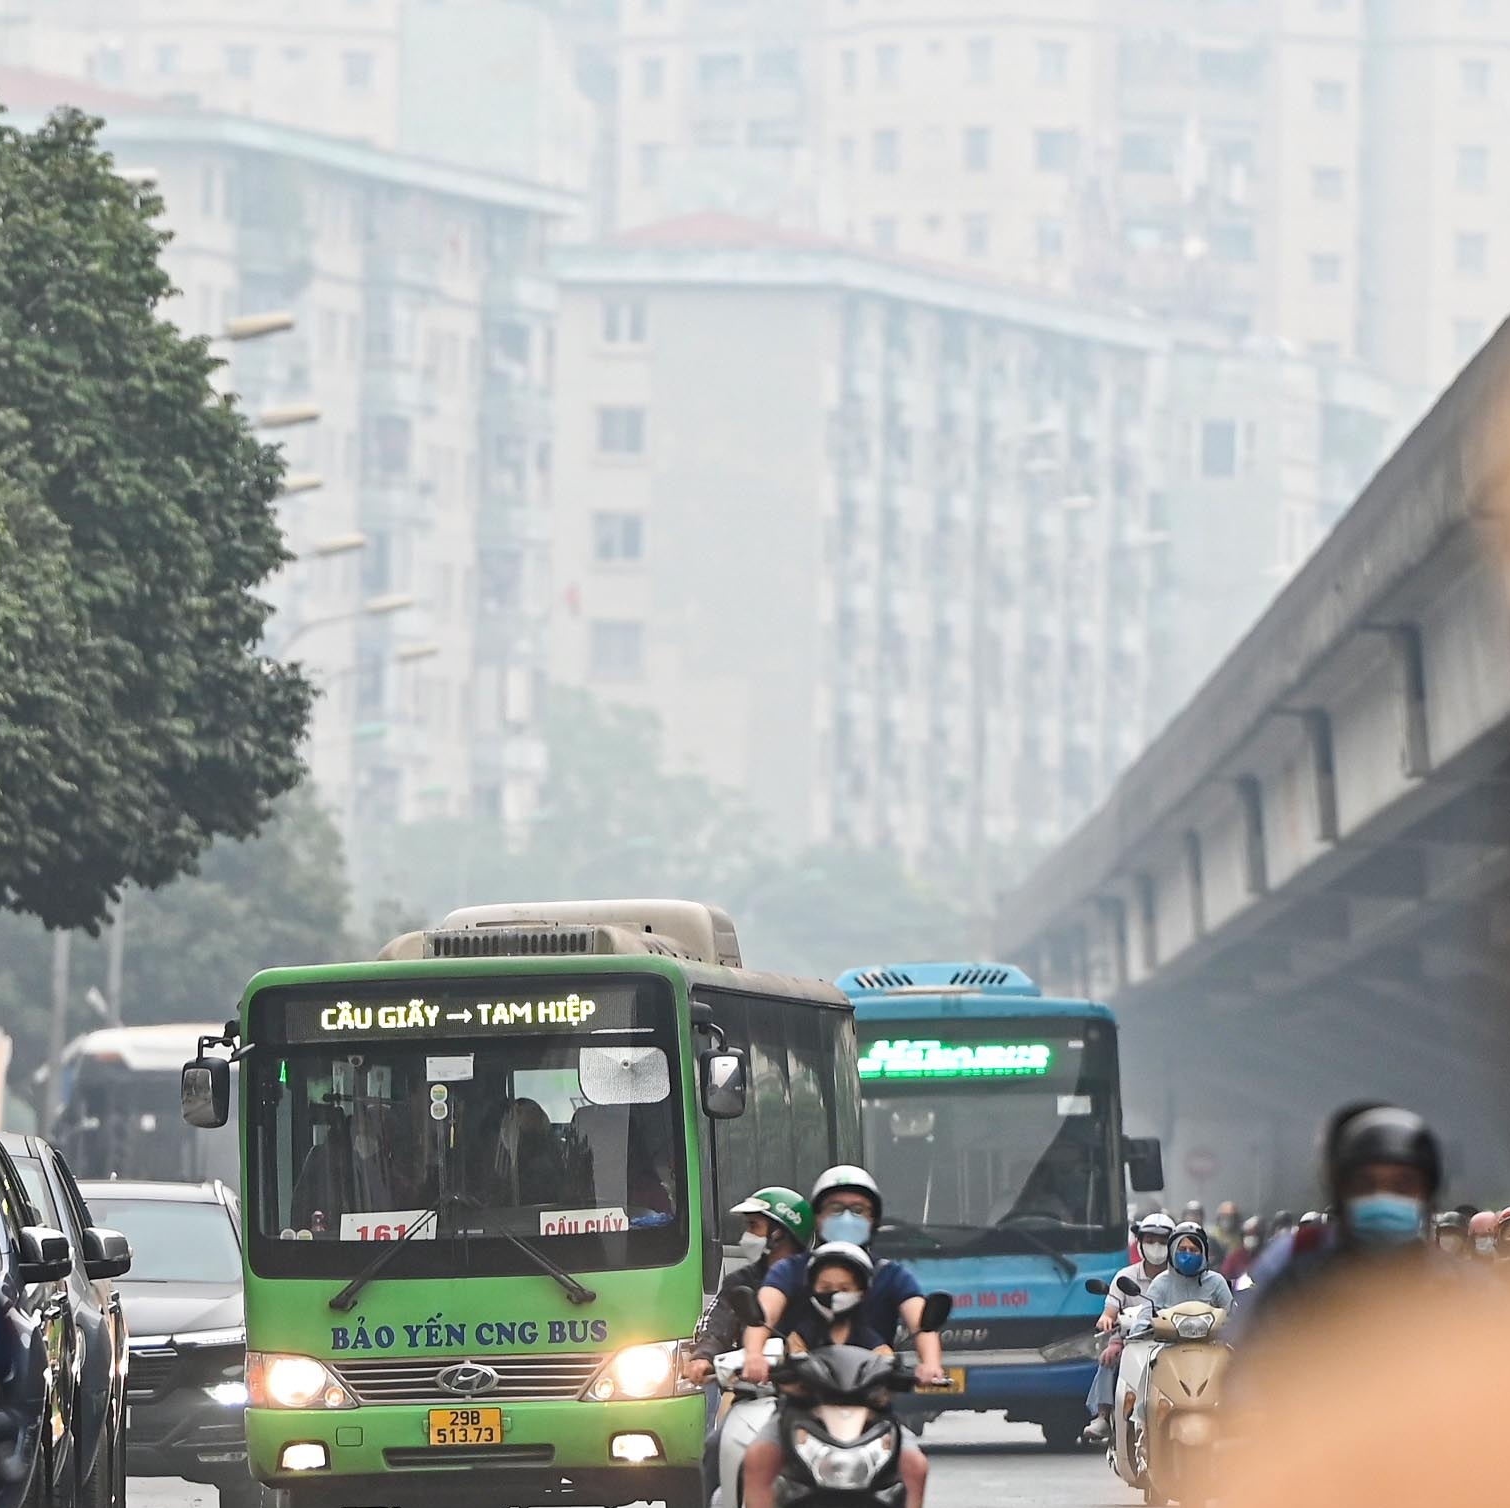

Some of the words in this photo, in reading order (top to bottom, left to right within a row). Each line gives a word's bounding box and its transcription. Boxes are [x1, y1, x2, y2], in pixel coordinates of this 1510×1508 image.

[320, 1001, 372, 1030] CẦU
[378, 999, 440, 1029] GIẤY
[476, 1002, 532, 1025] TAM
[537, 994, 596, 1026] HIỆP
[775, 1202, 802, 1224] Grab
[356, 1223, 407, 1241] 161
[331, 1316, 395, 1350] BẢO
[403, 1312, 466, 1347] YẾN
[475, 1321, 539, 1346] CNG
[547, 1319, 608, 1344] BUS
[449, 1410, 481, 1426] 29B
[437, 1427, 494, 1444] 513.73
